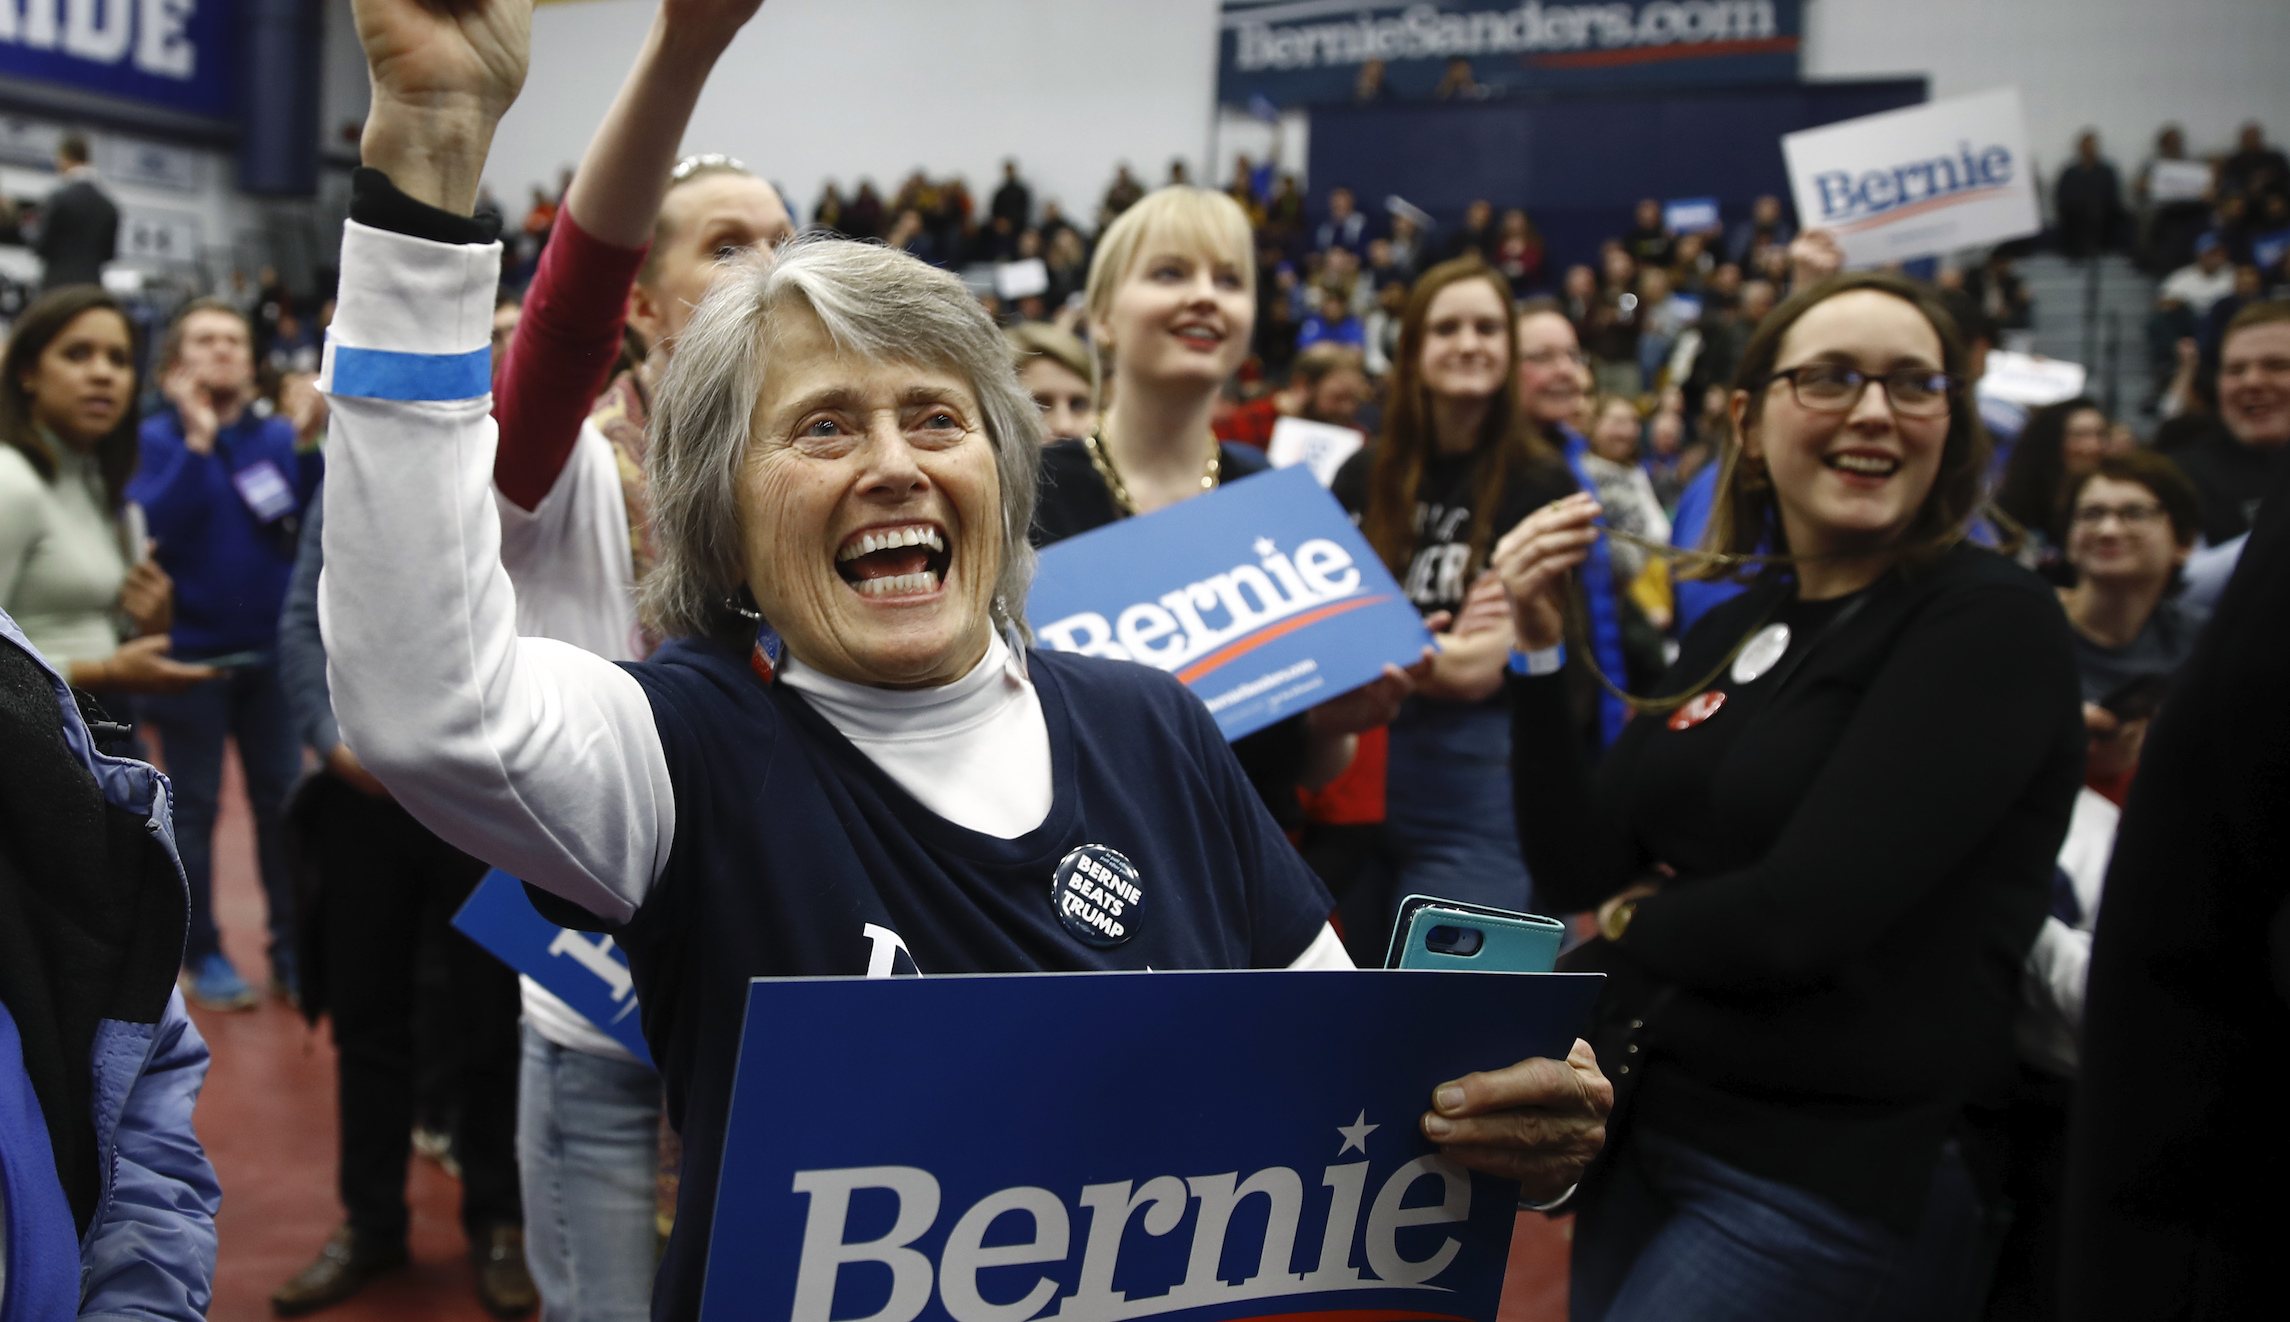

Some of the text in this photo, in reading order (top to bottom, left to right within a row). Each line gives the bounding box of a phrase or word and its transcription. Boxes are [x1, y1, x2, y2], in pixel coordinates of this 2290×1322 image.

[1237, 0, 1777, 71] BernieSanders.com
[1814, 140, 2013, 219] Bernie
[1038, 536, 1362, 672] Bernie
[1062, 889, 1125, 938] TRUMP
[1068, 871, 1124, 917] BEATS
[1077, 854, 1142, 906] BERNIE
[790, 1112, 1472, 1322] Bernie
